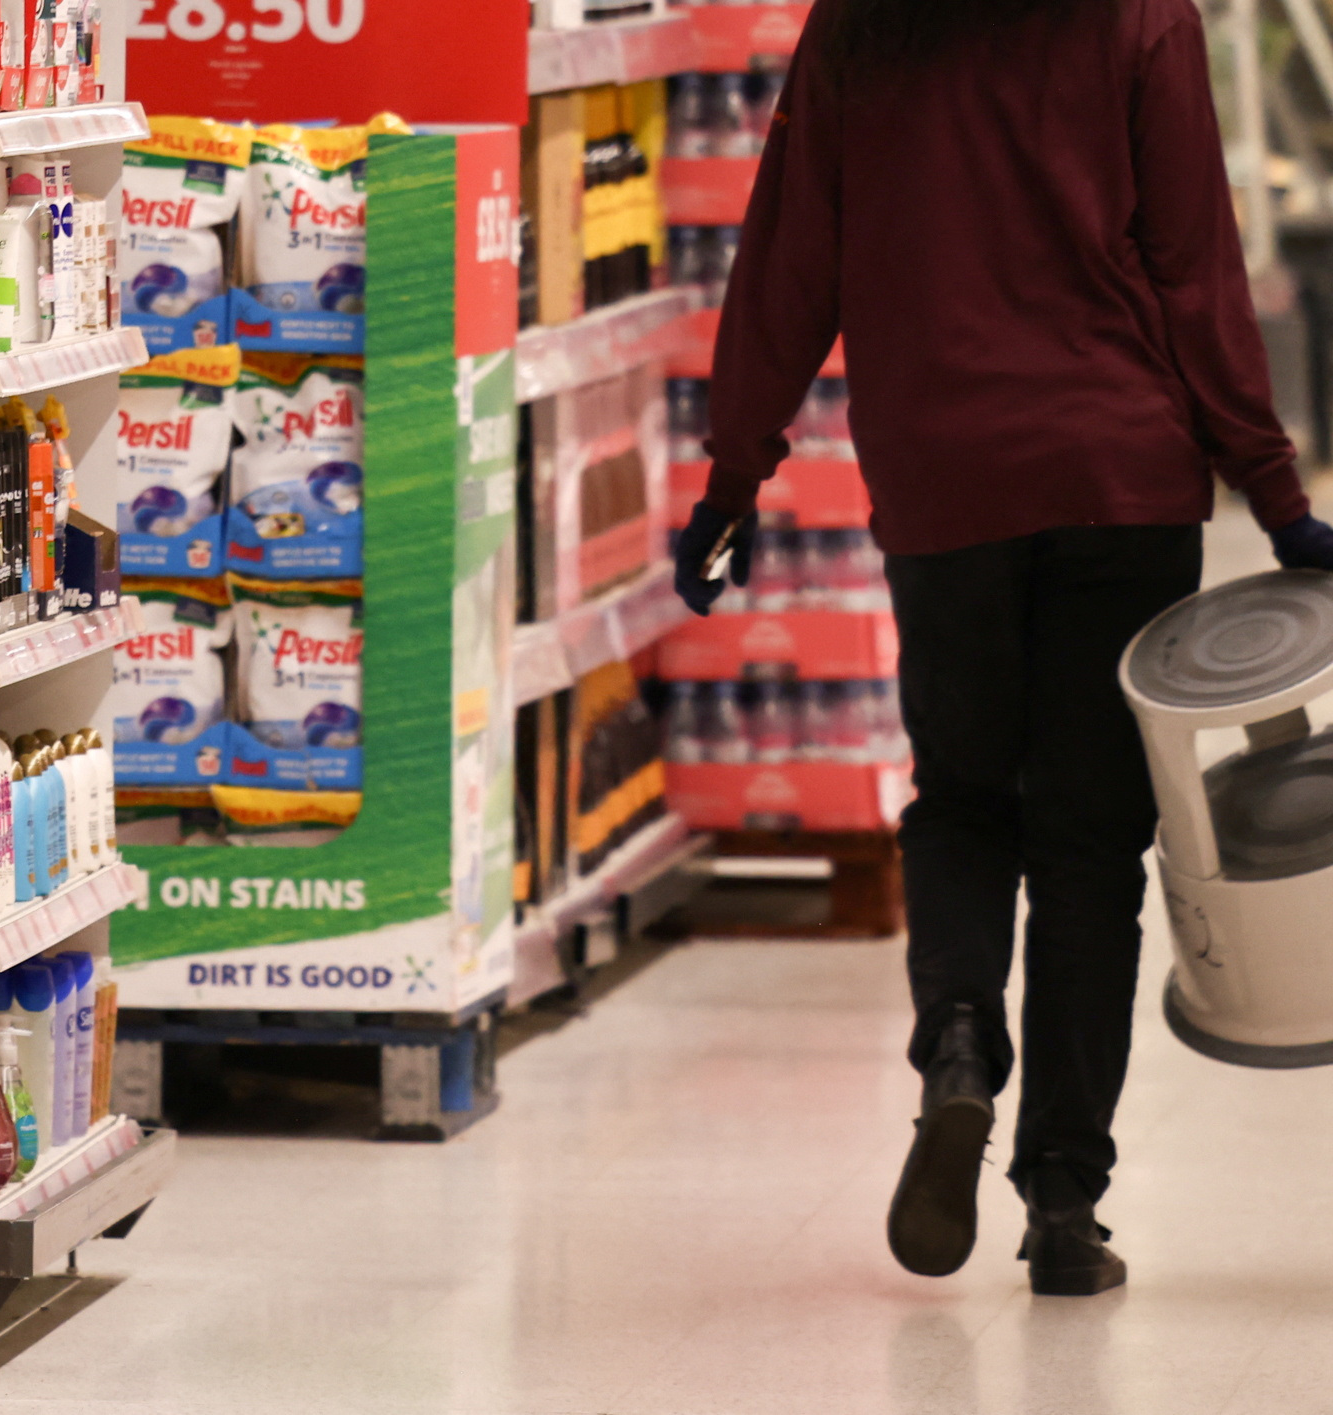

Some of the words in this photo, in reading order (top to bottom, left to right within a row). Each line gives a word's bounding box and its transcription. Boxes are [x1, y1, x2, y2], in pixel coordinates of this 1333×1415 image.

[192, 138, 239, 157] PACK
[186, 360, 232, 380] PACK
[274, 628, 364, 669] Persil
[160, 876, 220, 908] ON
[229, 877, 366, 911] STAINS
[188, 963, 257, 986] DIRT
[267, 965, 291, 986] IS
[300, 966, 393, 988] GOOD
